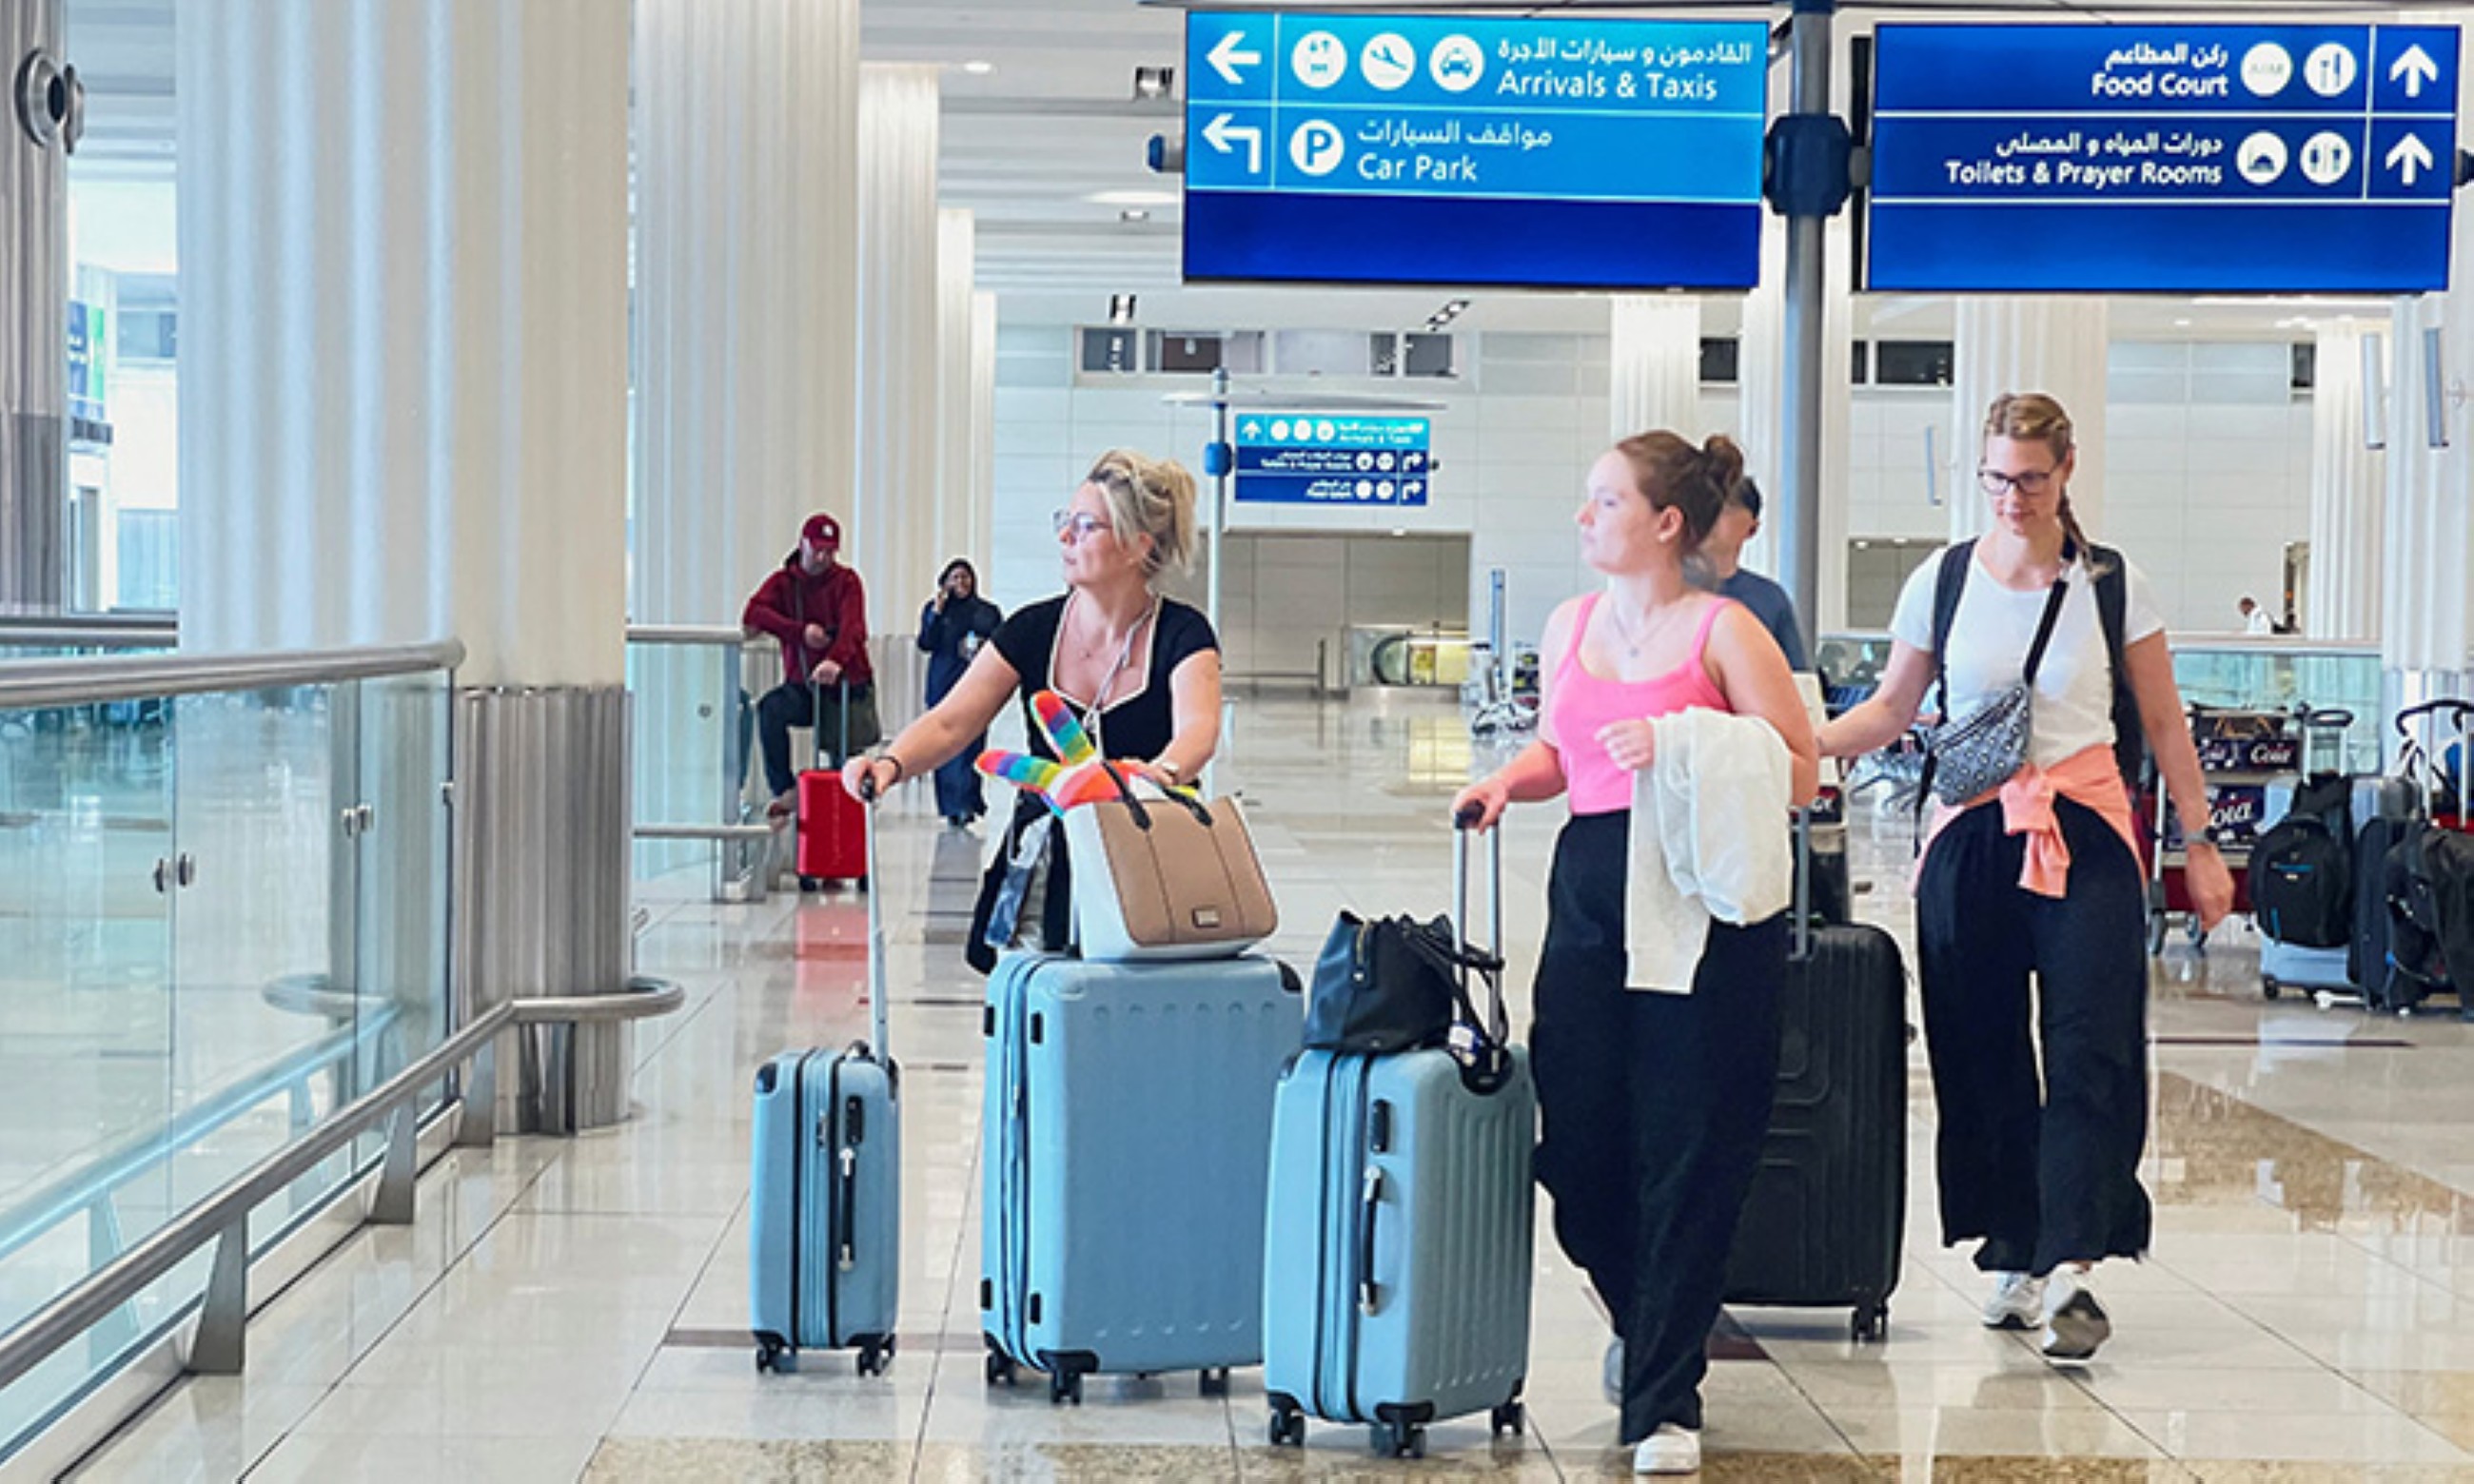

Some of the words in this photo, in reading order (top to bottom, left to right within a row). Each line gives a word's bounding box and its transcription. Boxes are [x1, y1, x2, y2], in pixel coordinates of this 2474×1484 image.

[1561, 38, 1637, 65] سيارات
[1641, 46, 1655, 67] و
[2105, 43, 2189, 71] المطاعم
[2190, 43, 2229, 69] ركن
[1497, 69, 1606, 98] Arrivals
[1616, 71, 1637, 98] &
[1645, 72, 1718, 101] Taxis
[2091, 71, 2153, 97] Food
[2158, 72, 2229, 97] Court
[1357, 119, 1461, 147] السيارات
[1465, 122, 1553, 150] مواقف
[2162, 132, 2223, 157] دورات
[2086, 138, 2100, 157] و
[1357, 152, 1405, 180] Car
[1415, 154, 1478, 182] Park
[1945, 161, 2026, 185] Toilets
[2032, 161, 2051, 185] &
[2057, 161, 2135, 190] Prayer
[2141, 161, 2223, 185] Rooms
